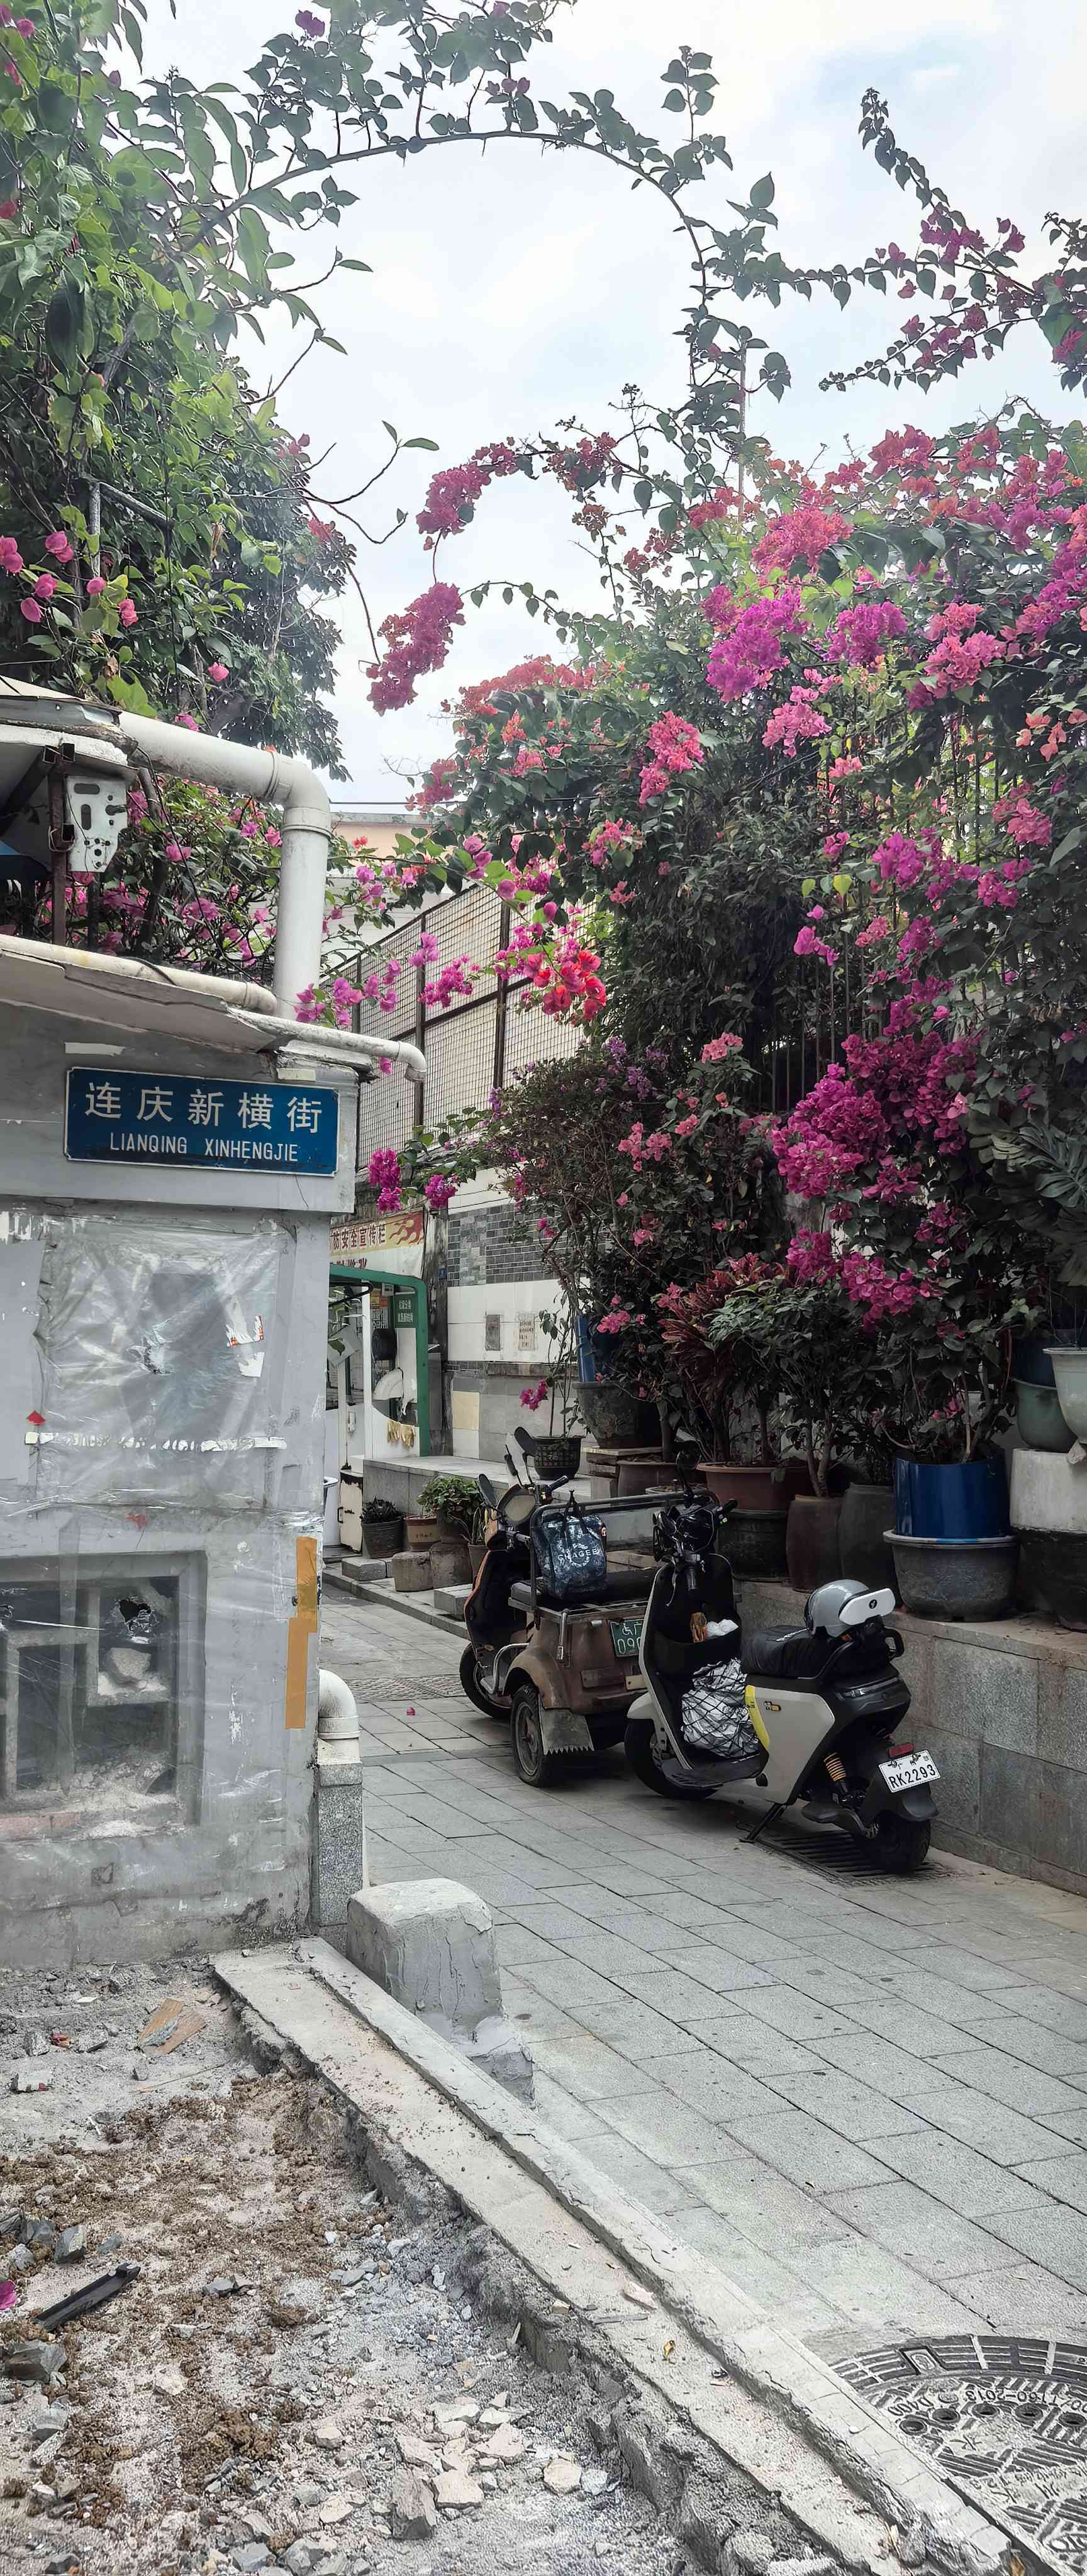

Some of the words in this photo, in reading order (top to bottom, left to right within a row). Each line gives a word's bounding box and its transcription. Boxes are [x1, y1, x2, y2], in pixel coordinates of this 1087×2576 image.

[86, 1082, 322, 1133] 连庆新横街
[110, 1132, 187, 1153] LIANQING
[205, 1138, 298, 1162] XINHENGJIE
[888, 1764, 936, 1788] RK2293
